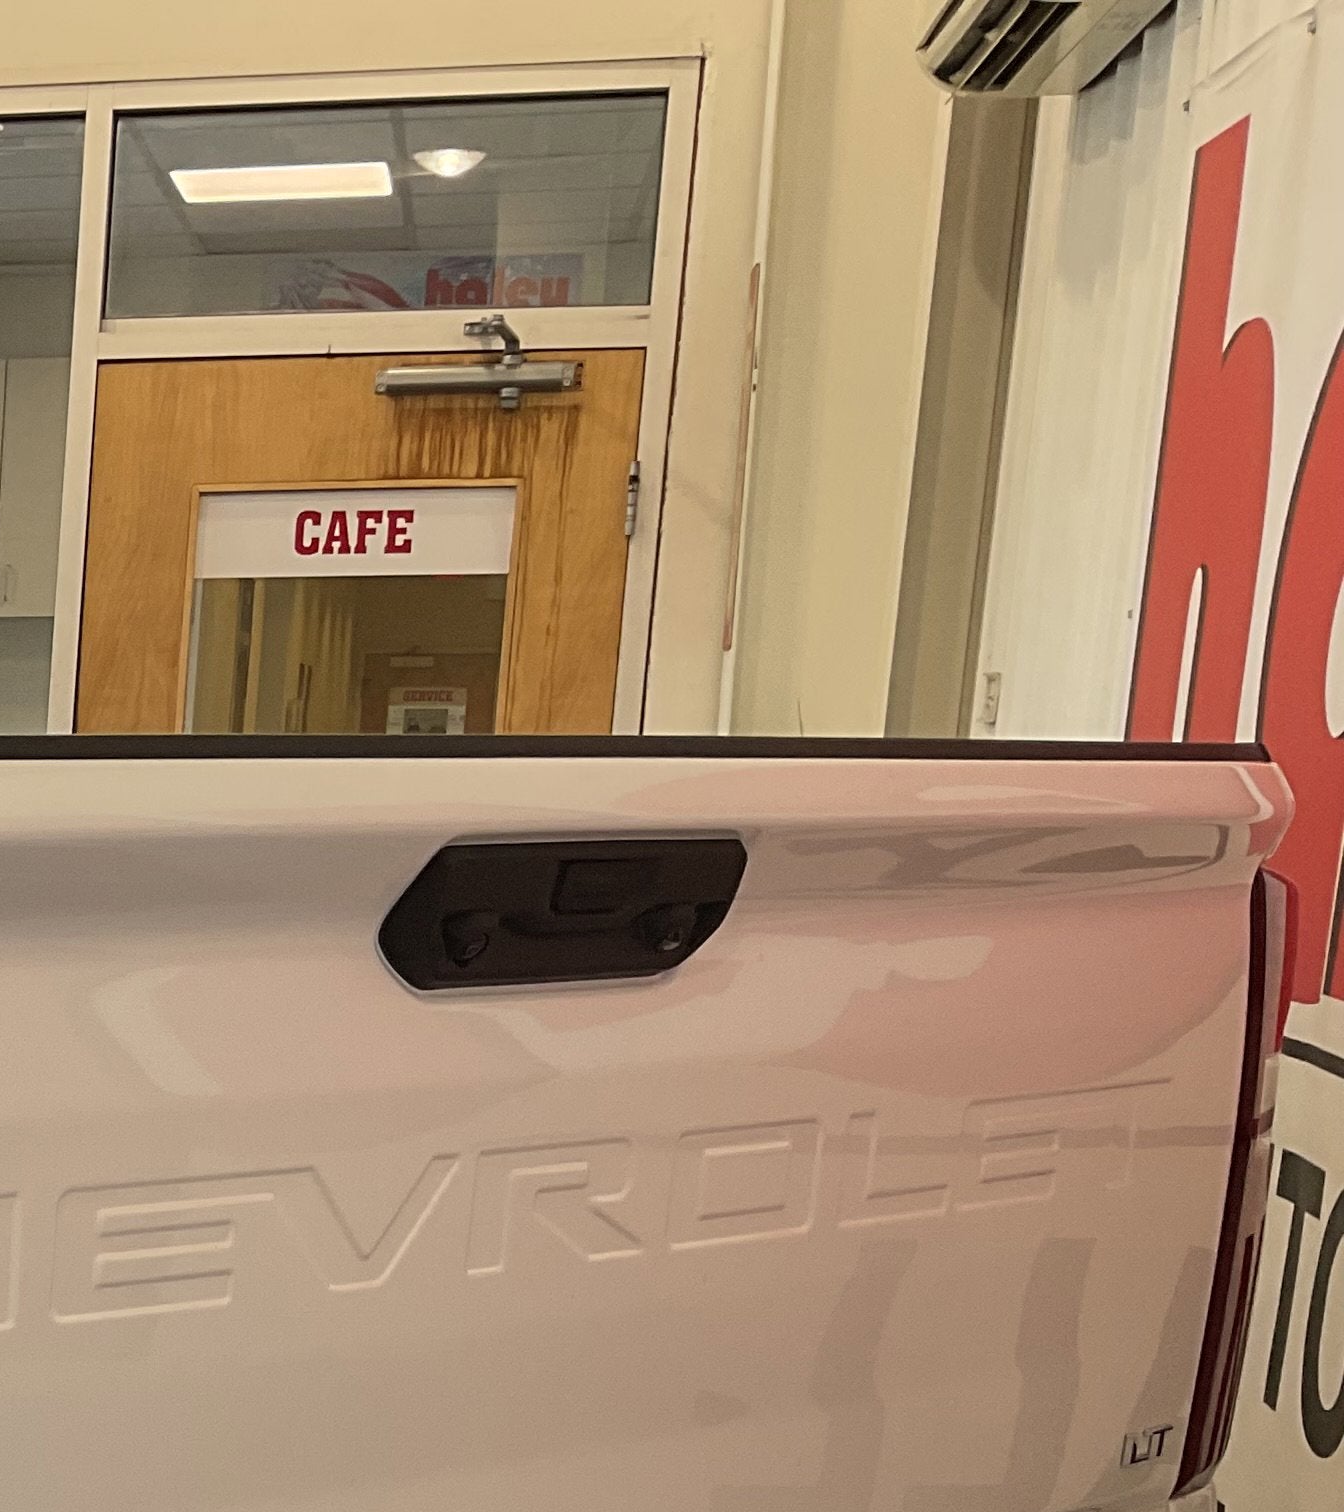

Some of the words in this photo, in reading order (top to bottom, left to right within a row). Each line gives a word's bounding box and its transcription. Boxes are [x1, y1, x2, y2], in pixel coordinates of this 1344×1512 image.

[294, 509, 415, 556] CAFE
[403, 689, 454, 703] SERVICE
[1119, 1423, 1174, 1470] LT
